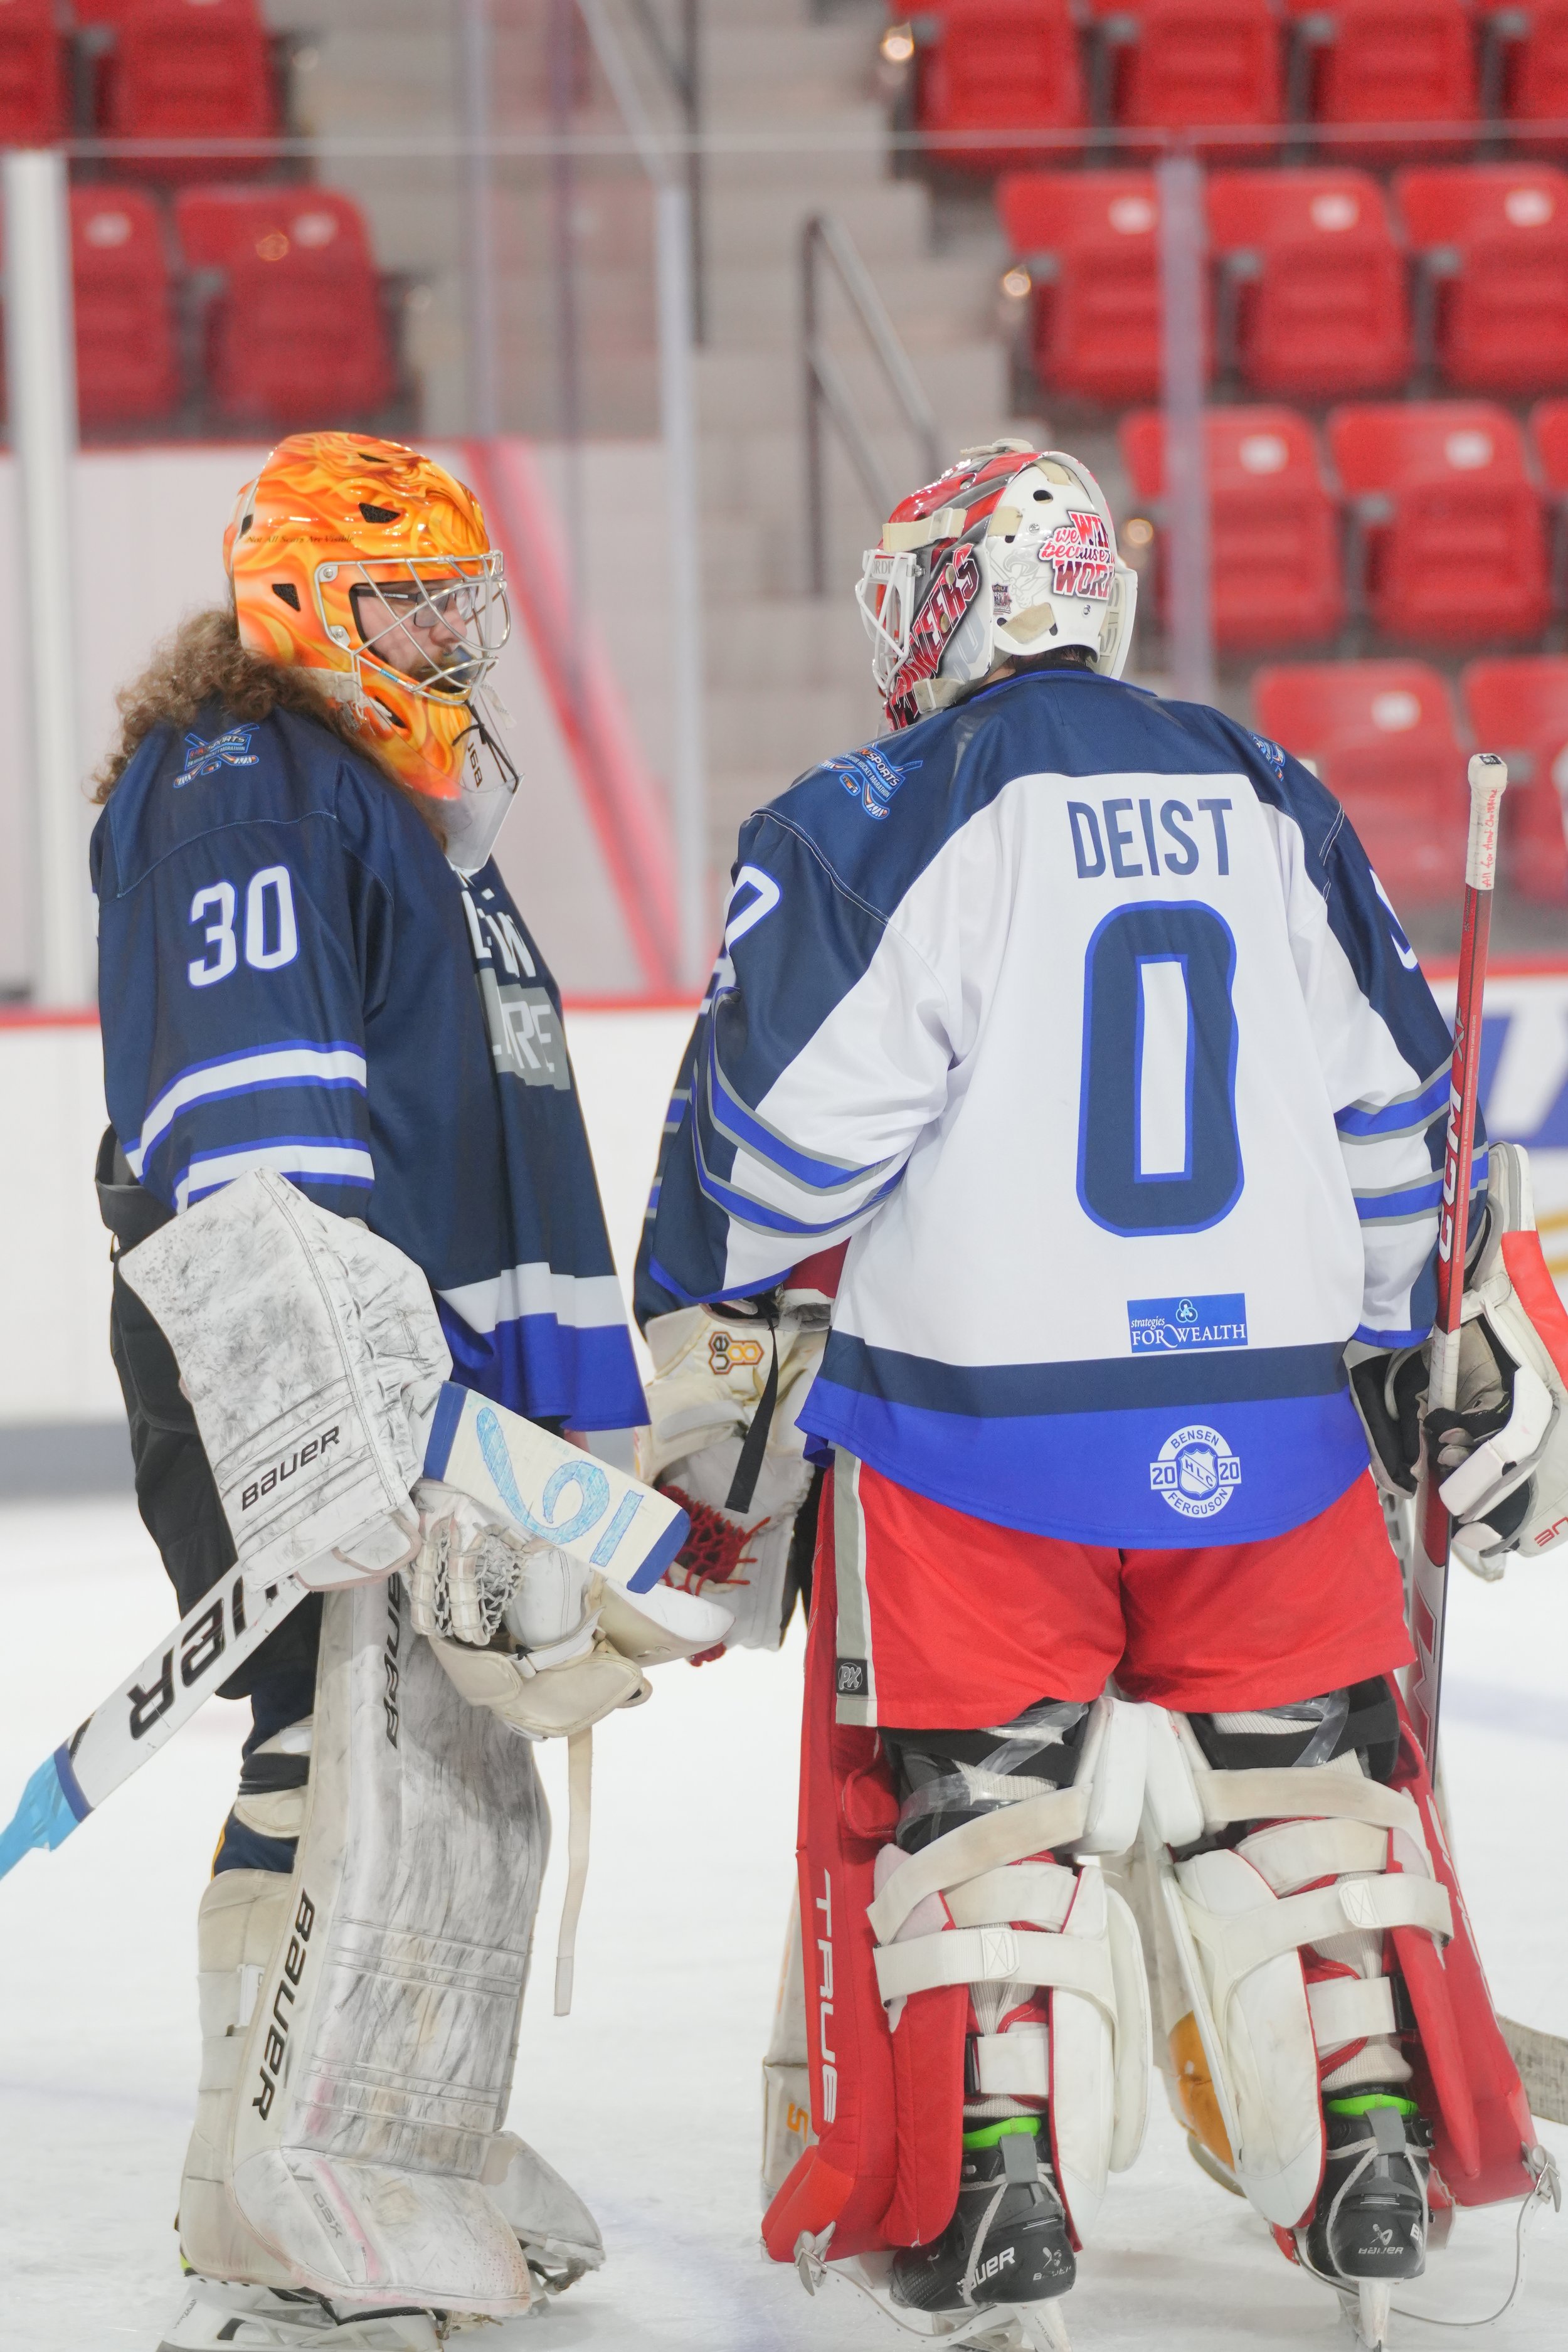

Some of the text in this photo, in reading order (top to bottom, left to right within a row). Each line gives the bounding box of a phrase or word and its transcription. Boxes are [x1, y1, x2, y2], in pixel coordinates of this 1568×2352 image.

[1041, 540, 1106, 563] because
[856, 759, 872, 777] HOCKEY
[869, 775, 891, 798] MARATHON
[866, 753, 900, 787] SPORTS
[1067, 798, 1233, 879] DEIST
[188, 864, 299, 988] 30
[1076, 899, 1245, 1237] 0
[1439, 1080, 1461, 1263] CCM
[1131, 1316, 1165, 1330] strategies
[1131, 1324, 1246, 1348] FOR WEALTH
[1170, 1430, 1219, 1449] BENSEN
[242, 1425, 341, 1512] BAUER
[1152, 1461, 1239, 1485] 20 20
[1185, 1458, 1214, 1487] HLC
[1167, 1488, 1228, 1515] FERGUSON
[126, 1575, 280, 1740] UER
[383, 1571, 401, 1750] BAUE
[839, 1666, 862, 1691] PX
[252, 1887, 315, 2121] BAUER
[812, 1867, 838, 2125] TRUE
[1358, 2247, 1404, 2255] BAUER
[956, 2247, 1015, 2296] UER
[1033, 2265, 1072, 2281] BUER
